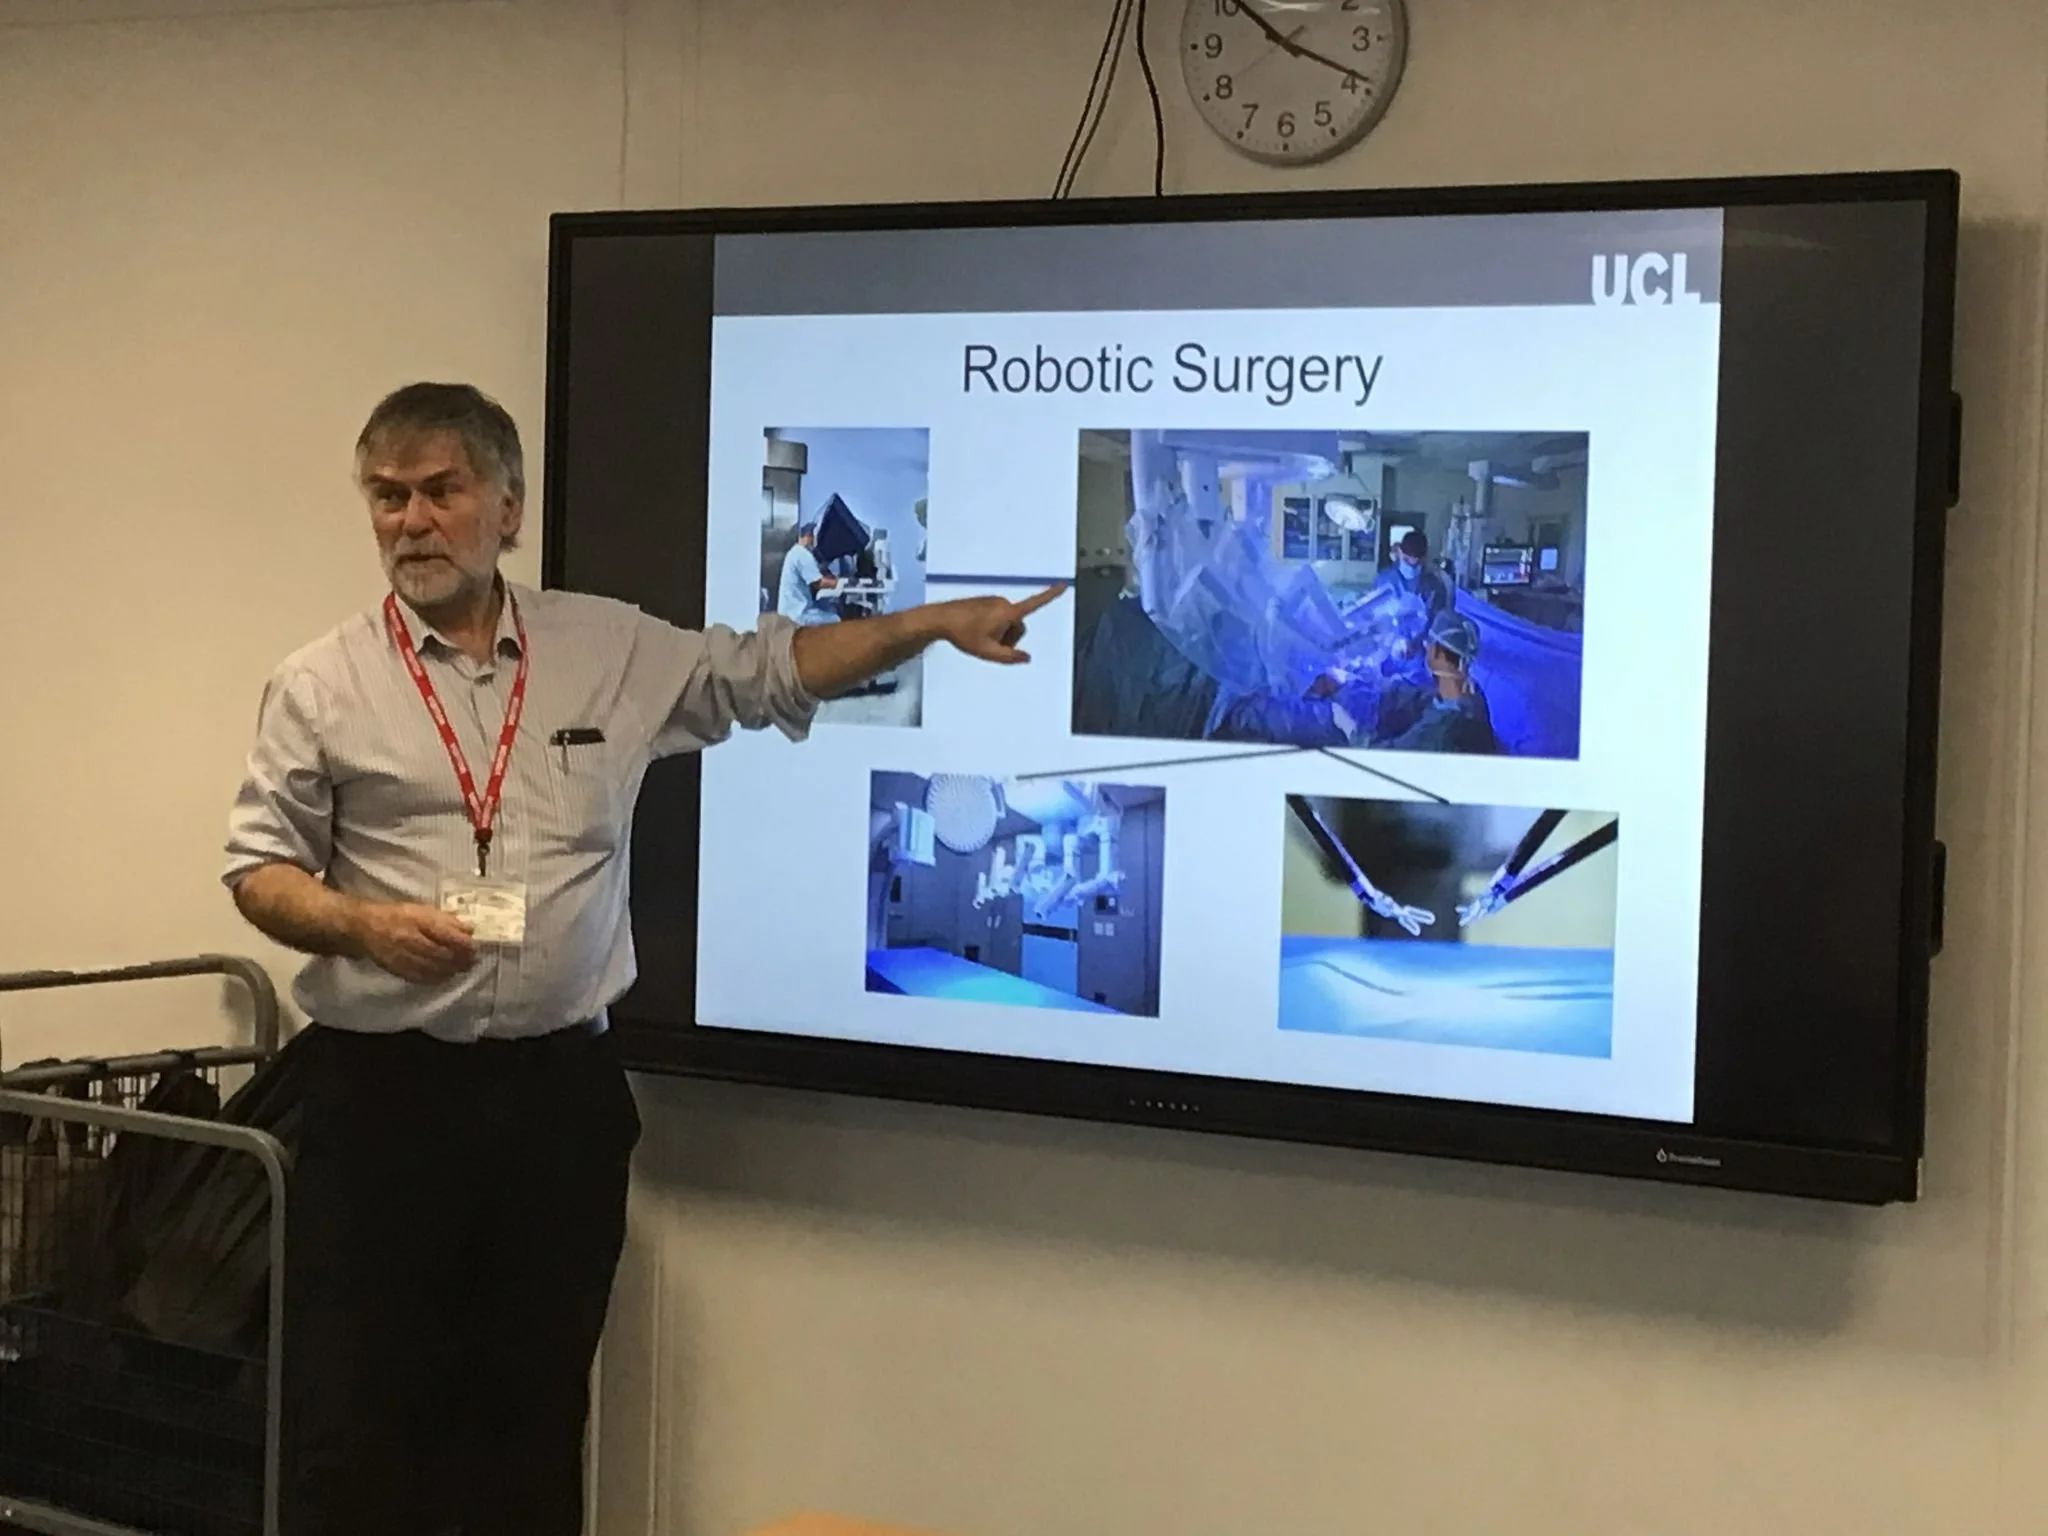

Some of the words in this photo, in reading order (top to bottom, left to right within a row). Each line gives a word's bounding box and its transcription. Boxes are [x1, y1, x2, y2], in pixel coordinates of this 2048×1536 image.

[1204, 33, 1222, 58] 9
[1352, 25, 1370, 51] 3
[1215, 74, 1233, 99] 8
[1341, 69, 1360, 95] 4
[1242, 103, 1259, 129] 7
[1277, 112, 1295, 138] 6
[1314, 102, 1332, 126] 5
[1592, 252, 1701, 307] UCL
[963, 344, 1154, 394] Robotic
[1172, 343, 1384, 406] Surgery
